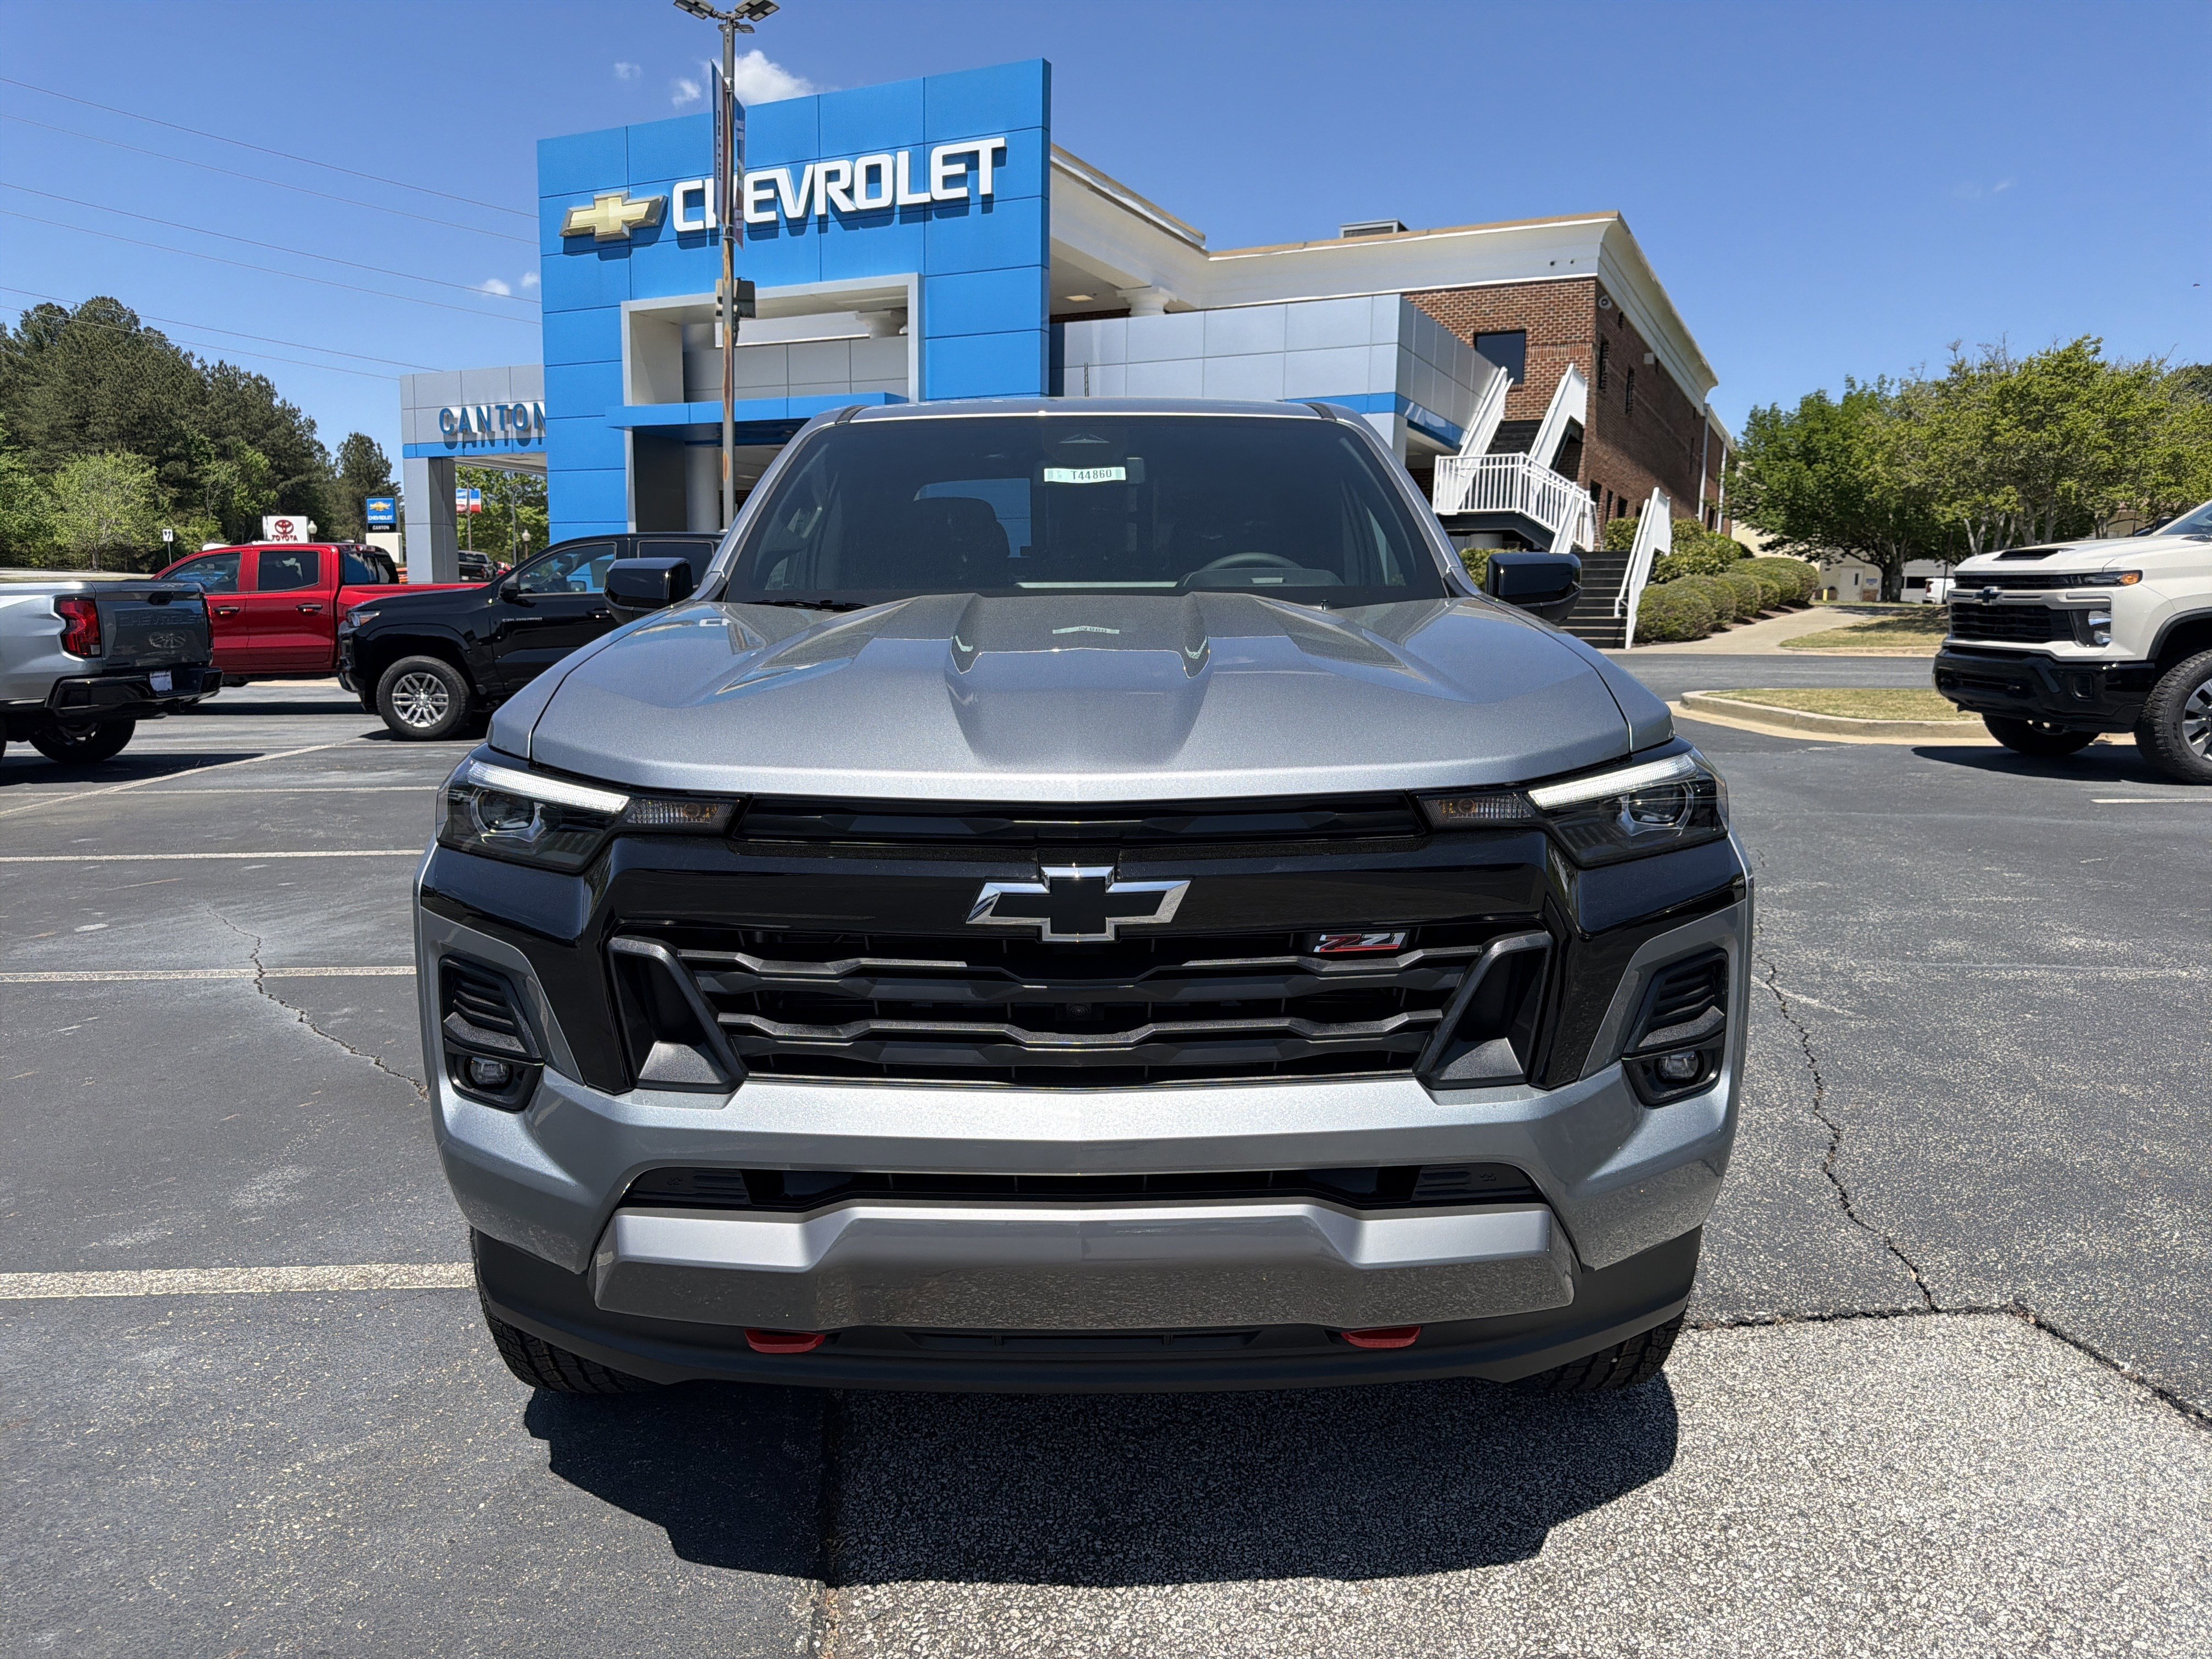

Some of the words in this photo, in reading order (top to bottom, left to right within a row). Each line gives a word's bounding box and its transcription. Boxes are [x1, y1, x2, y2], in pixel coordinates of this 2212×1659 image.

[439, 402, 546, 436] CANTON
[1070, 469, 1112, 480] T44860
[271, 534, 298, 542] TOYOTA
[1313, 932, 1406, 953] Z71
